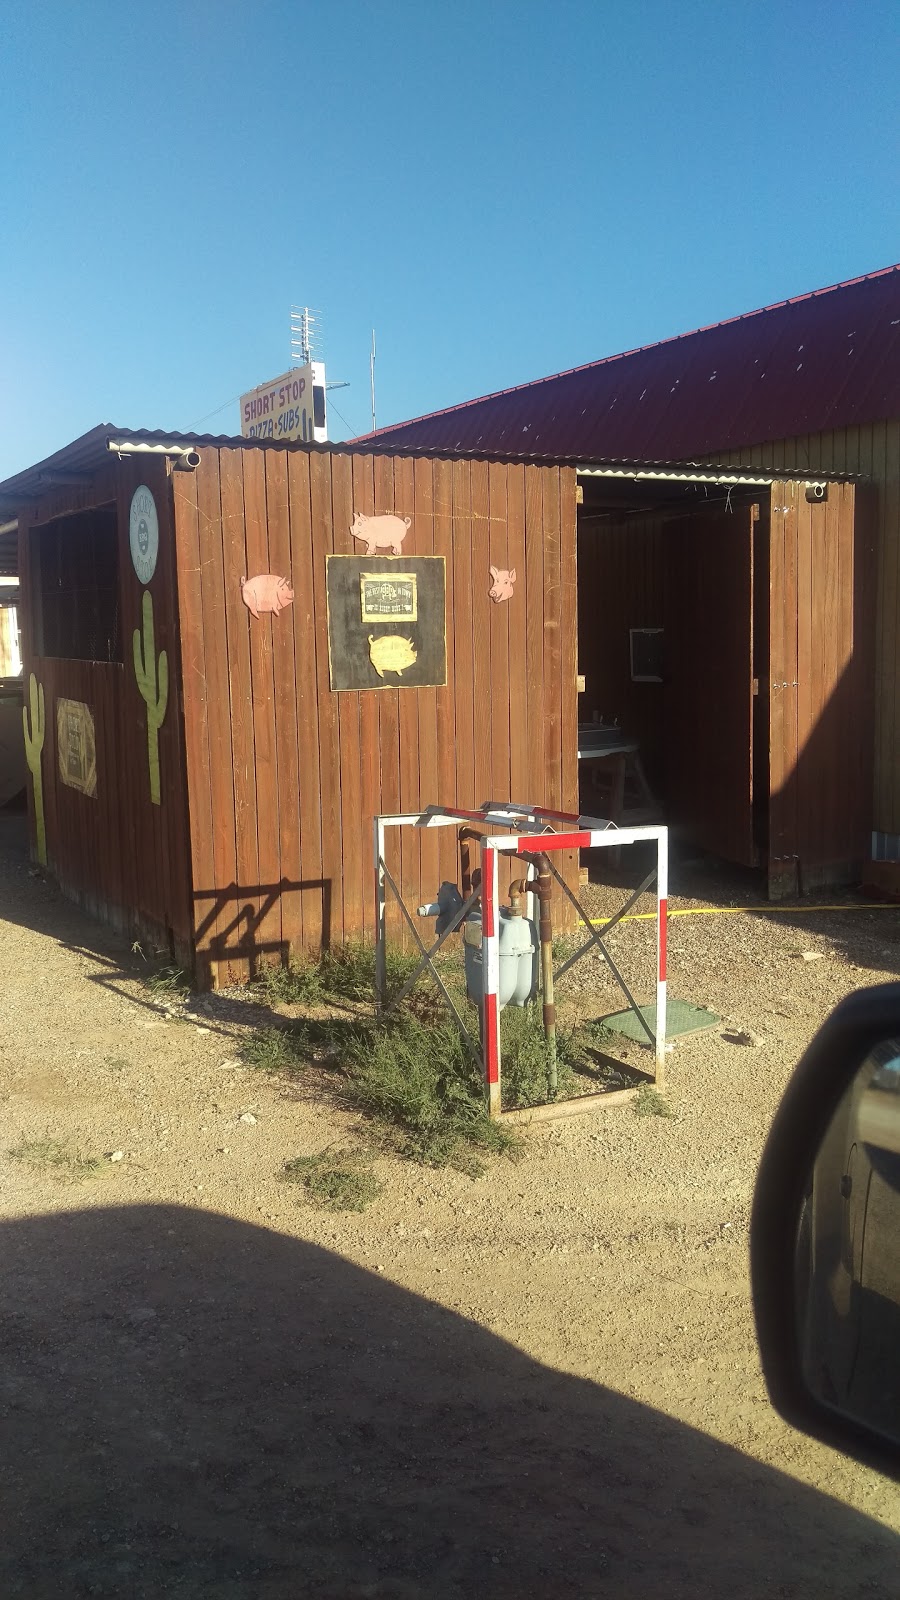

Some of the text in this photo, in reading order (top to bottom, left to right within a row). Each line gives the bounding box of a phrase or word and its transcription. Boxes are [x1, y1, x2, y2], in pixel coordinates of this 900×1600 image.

[245, 378, 305, 422] SHORT STOP
[249, 406, 300, 438] PIZZA SUBS
[133, 494, 153, 521] SHORT
